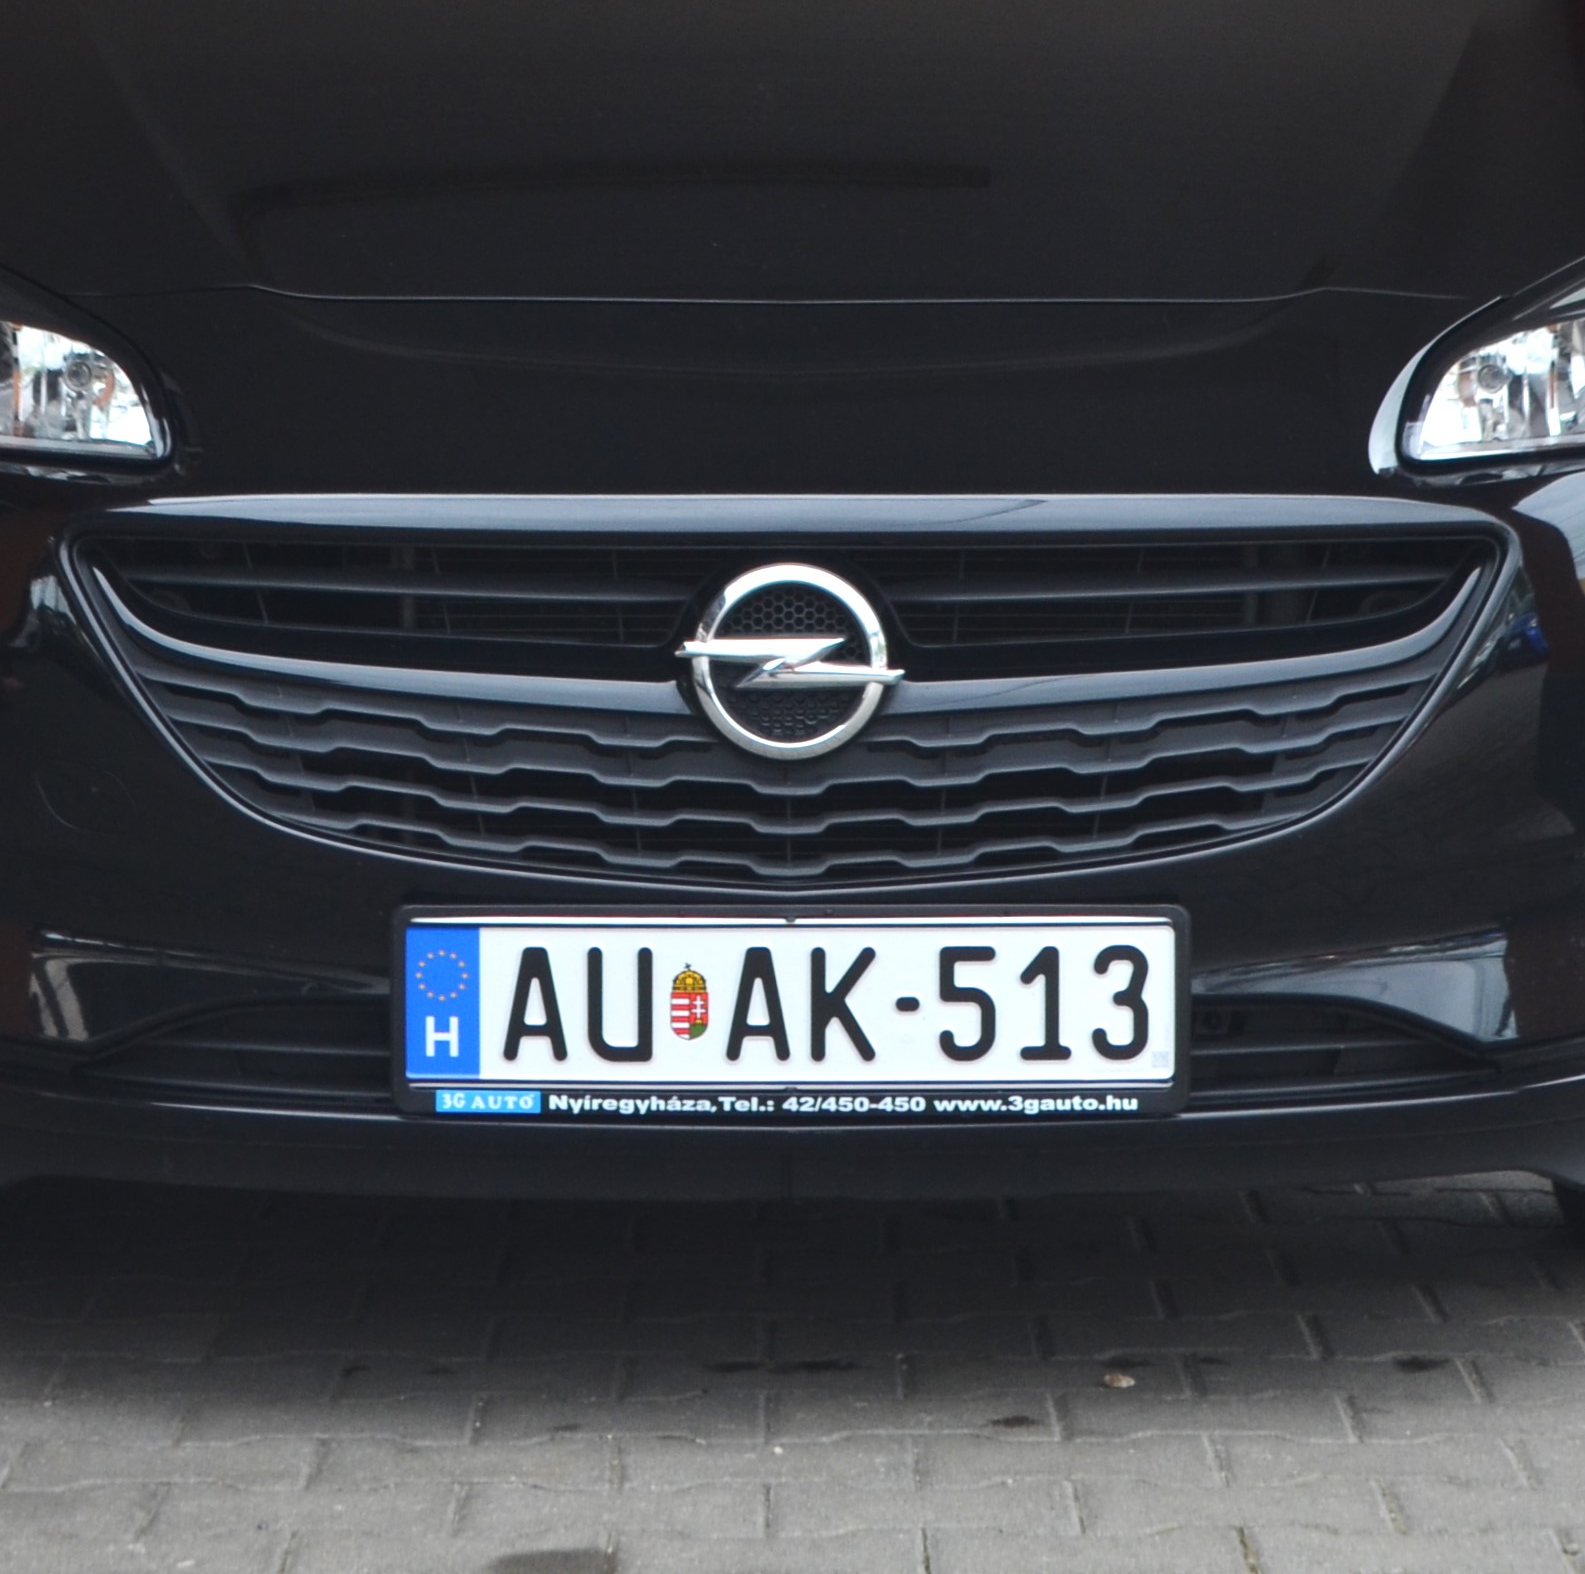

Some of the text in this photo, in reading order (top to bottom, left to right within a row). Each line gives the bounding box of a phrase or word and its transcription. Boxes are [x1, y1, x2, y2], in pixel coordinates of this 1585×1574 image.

[502, 944, 1150, 1063] AU AK-513
[425, 1015, 460, 1058] H
[442, 1092, 466, 1110] 3G
[471, 1093, 536, 1110] AUTÓ
[781, 1095, 927, 1112] 42/450-450
[932, 1094, 1140, 1114] www.3gauto.hu
